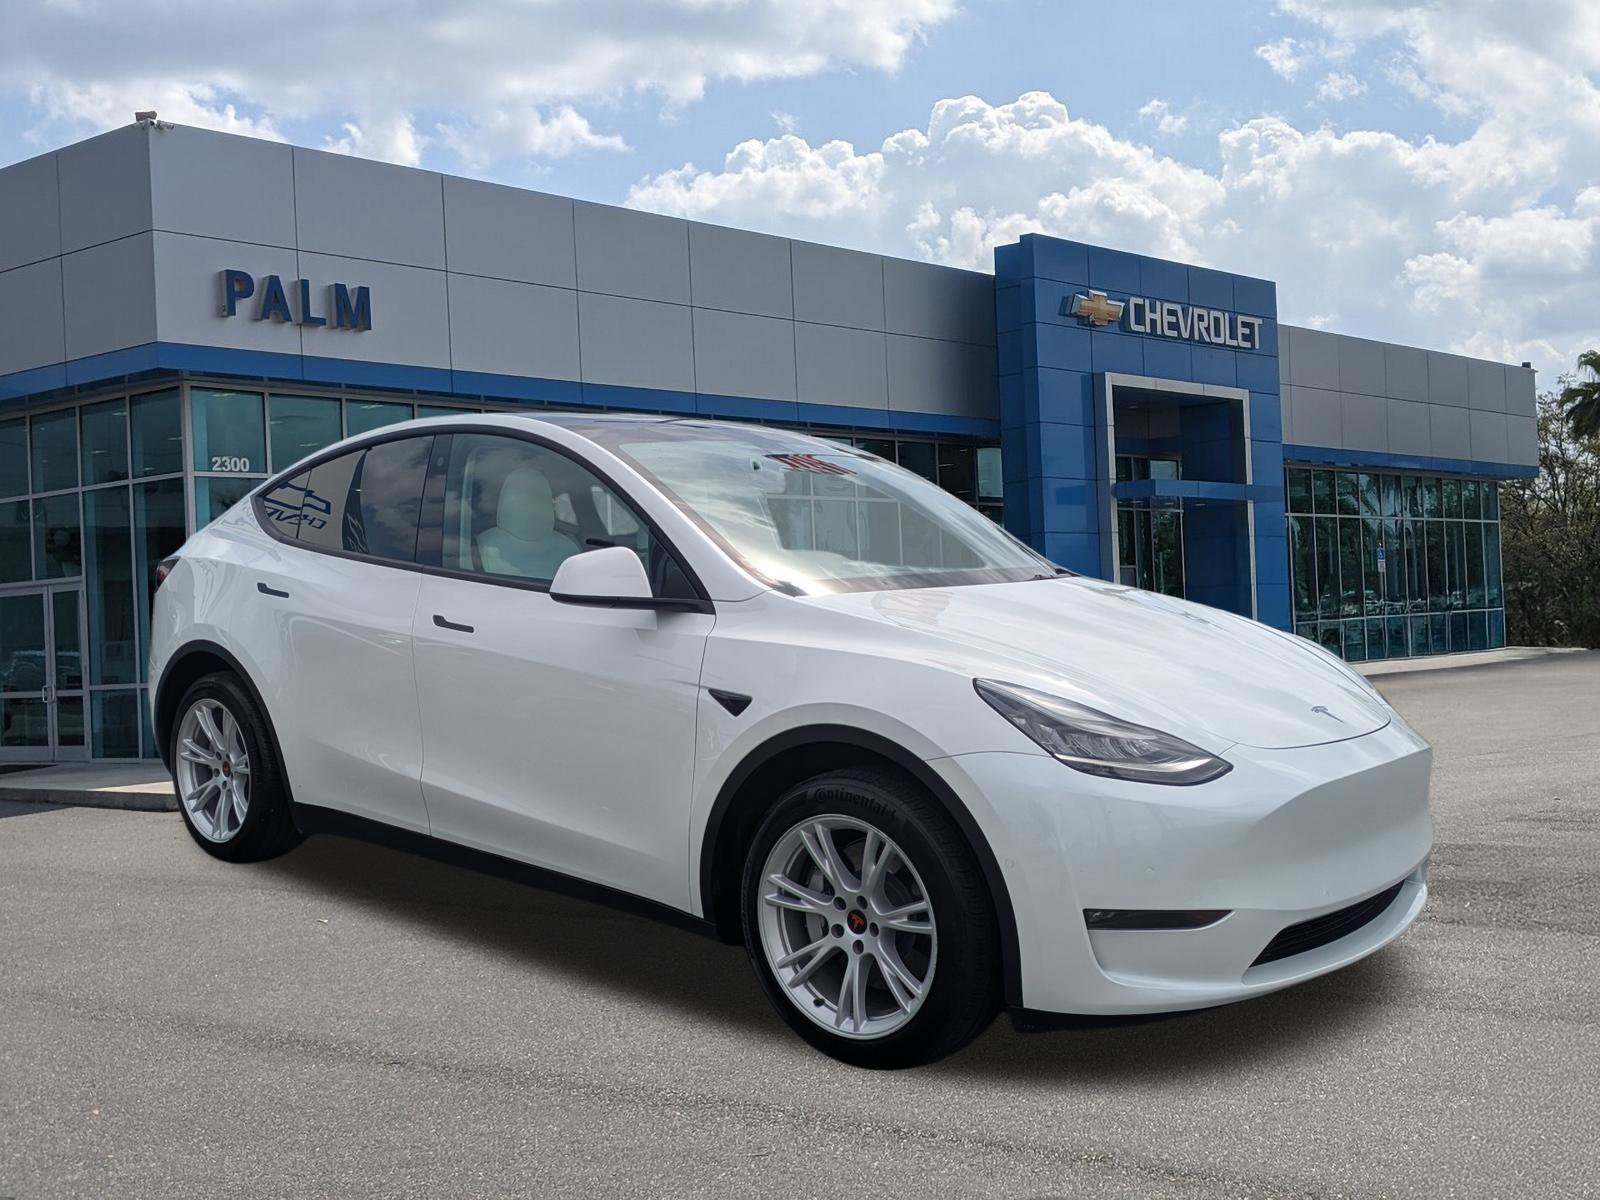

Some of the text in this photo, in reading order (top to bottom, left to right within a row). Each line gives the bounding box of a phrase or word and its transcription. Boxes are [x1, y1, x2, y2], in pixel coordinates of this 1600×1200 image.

[222, 268, 372, 331] PALM
[1129, 297, 1263, 349] CHEVROLET
[212, 456, 250, 472] 2300
[815, 787, 889, 817] Continental
